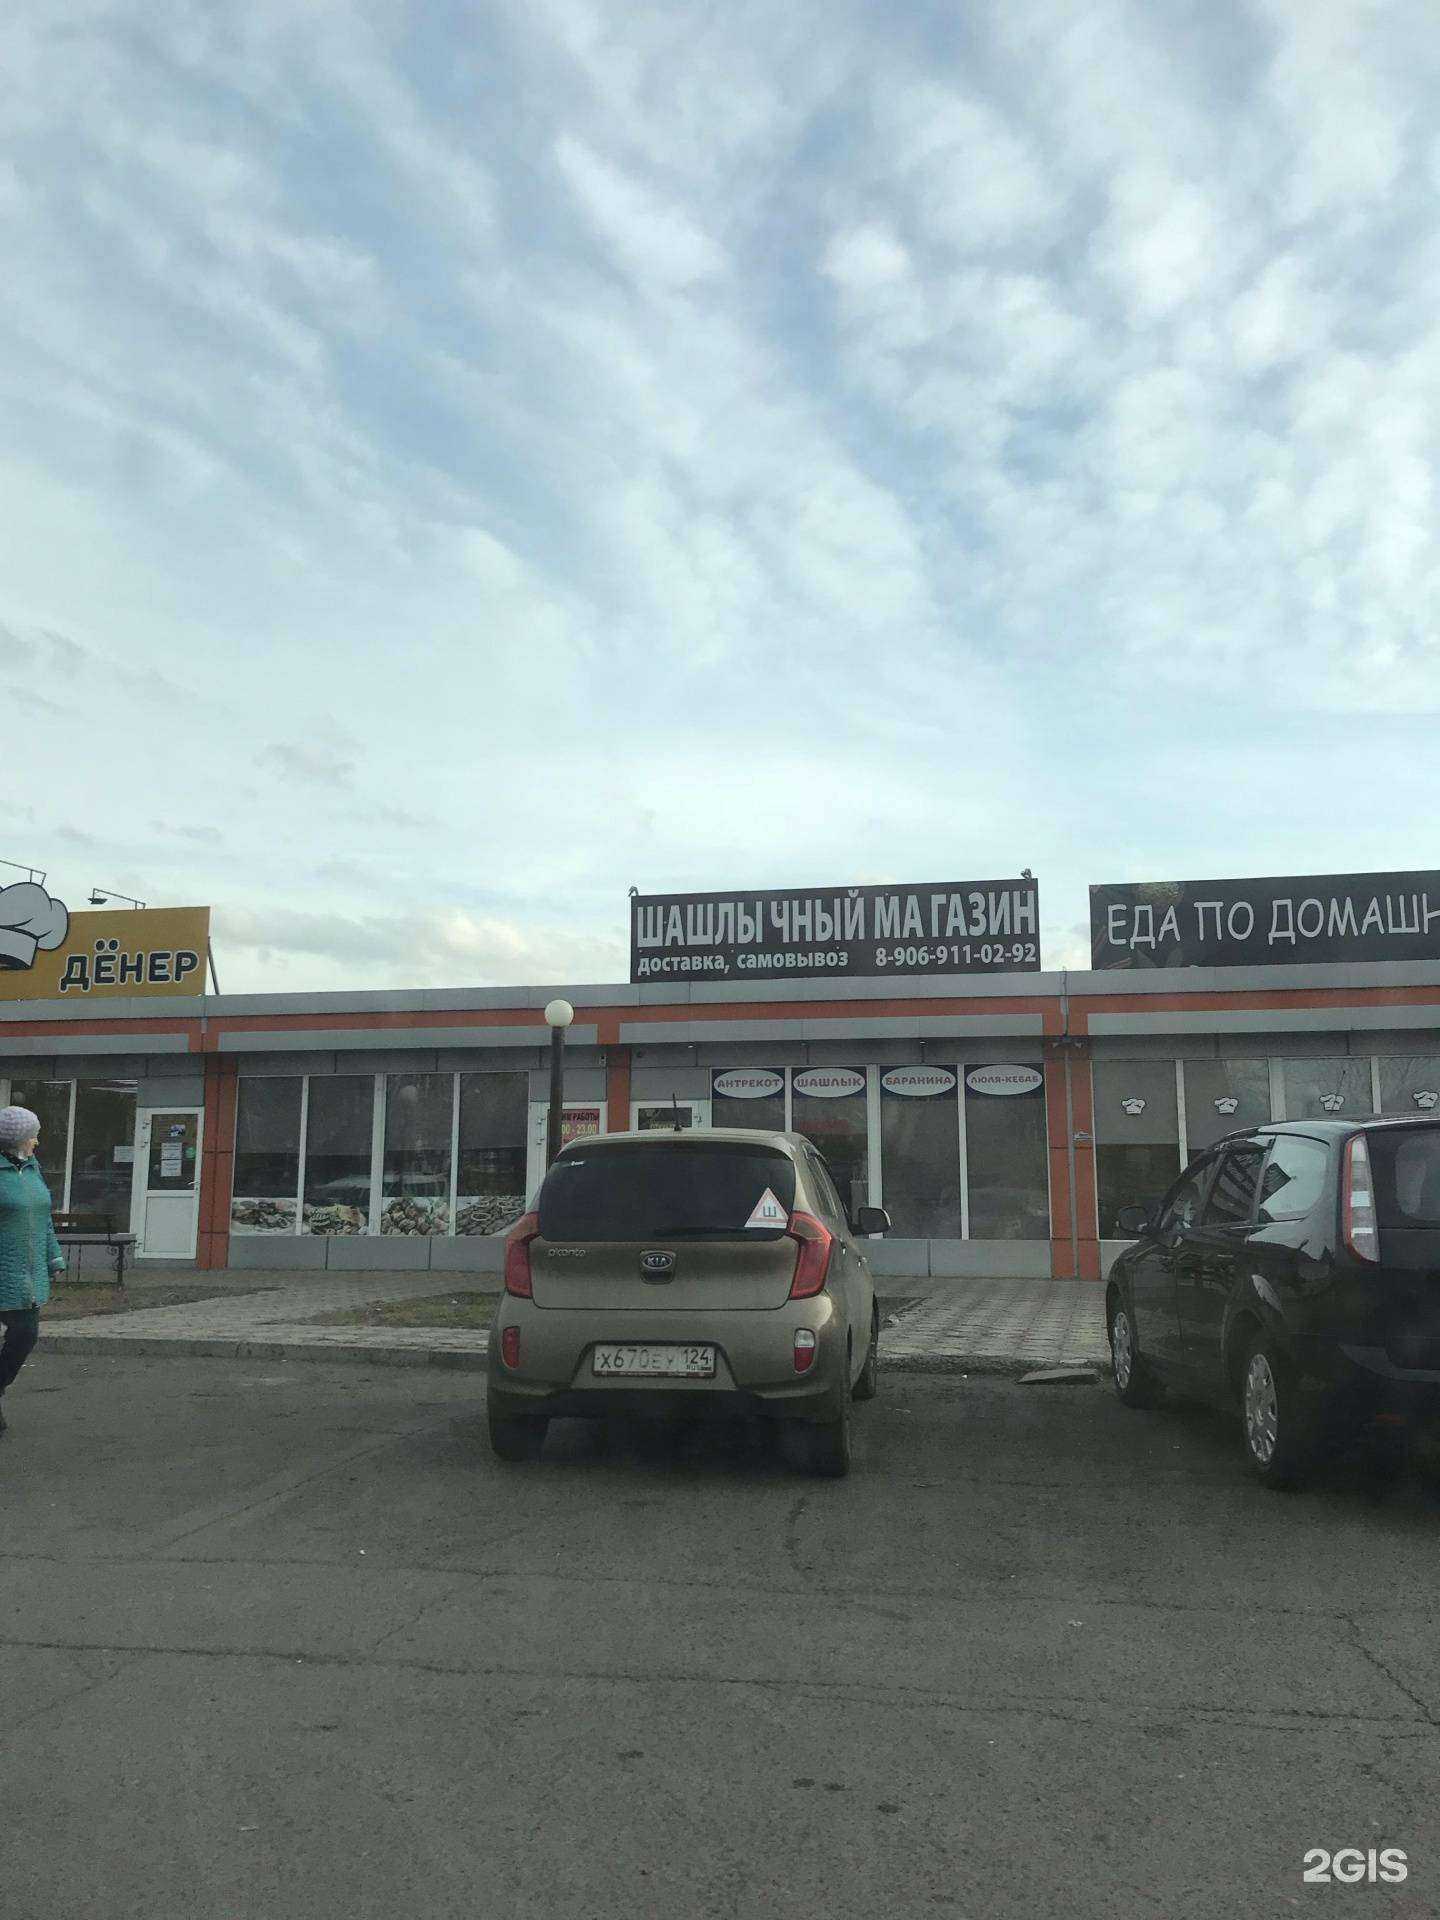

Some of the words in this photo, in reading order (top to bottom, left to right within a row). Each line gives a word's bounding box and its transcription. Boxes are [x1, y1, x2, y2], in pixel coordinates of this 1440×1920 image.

[1107, 903, 1181, 950] ЕДА
[1193, 900, 1255, 942] ПО
[637, 954, 730, 977] доставка,
[736, 951, 849, 969] самовывоз
[875, 942, 1037, 967] 8-906-911-02-92
[59, 938, 199, 993] ДЁНЕР
[717, 1078, 781, 1089] АНТРЕКОТ
[797, 1077, 862, 1088] ШАШЛЫК
[885, 1076, 952, 1086] БАРАНИНА
[971, 1075, 1040, 1084] ЛЮЛЯ-КЕБАБ
[647, 1257, 667, 1266] KIA
